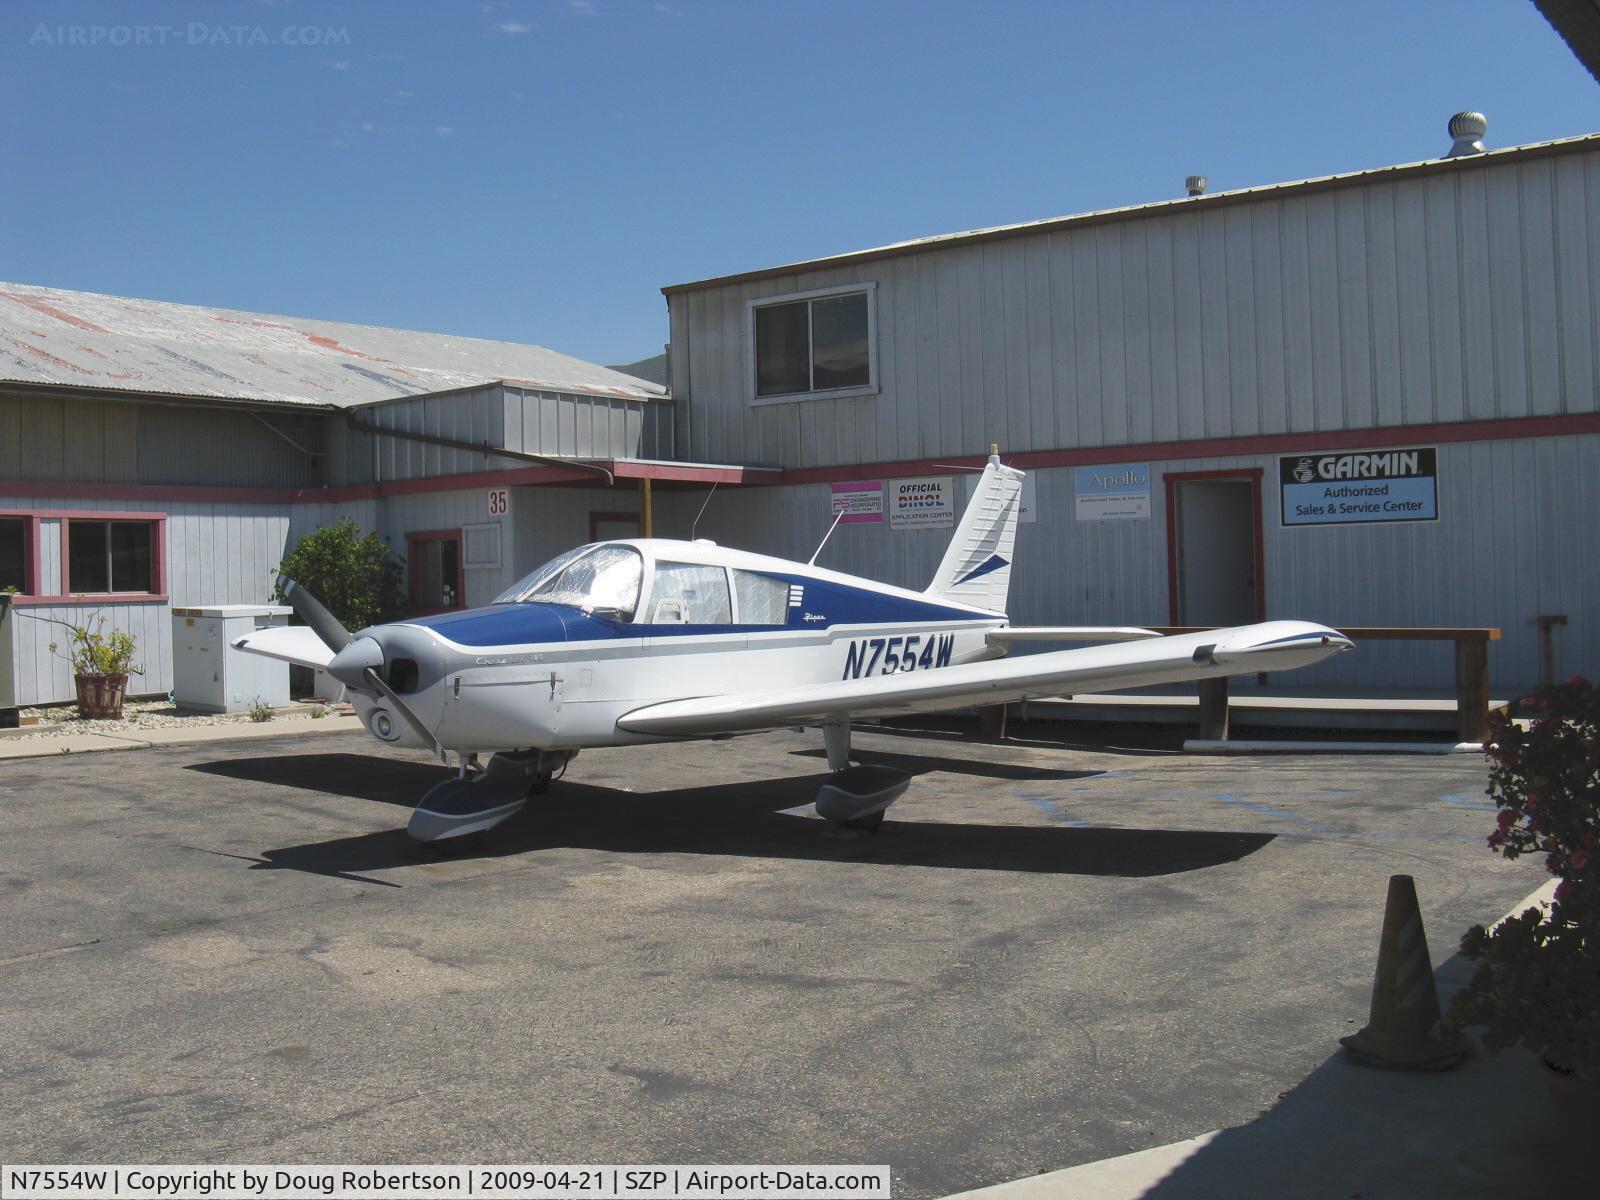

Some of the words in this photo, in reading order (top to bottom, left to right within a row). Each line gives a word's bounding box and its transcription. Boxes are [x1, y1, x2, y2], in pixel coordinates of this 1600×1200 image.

[1318, 452, 1418, 480] GARMIN
[899, 483, 943, 494] OFFICIAL
[1088, 471, 1146, 491] Apollo
[1324, 484, 1389, 498] Authorized
[490, 491, 507, 514] 35
[898, 494, 944, 508] DINOL
[1296, 504, 1324, 516] Sales
[1327, 505, 1336, 514] &
[1340, 502, 1380, 514] Service
[1383, 500, 1423, 512] Center
[891, 513, 929, 521] APPLICATION
[930, 511, 953, 519] CENTER
[842, 632, 955, 680] N7554W
